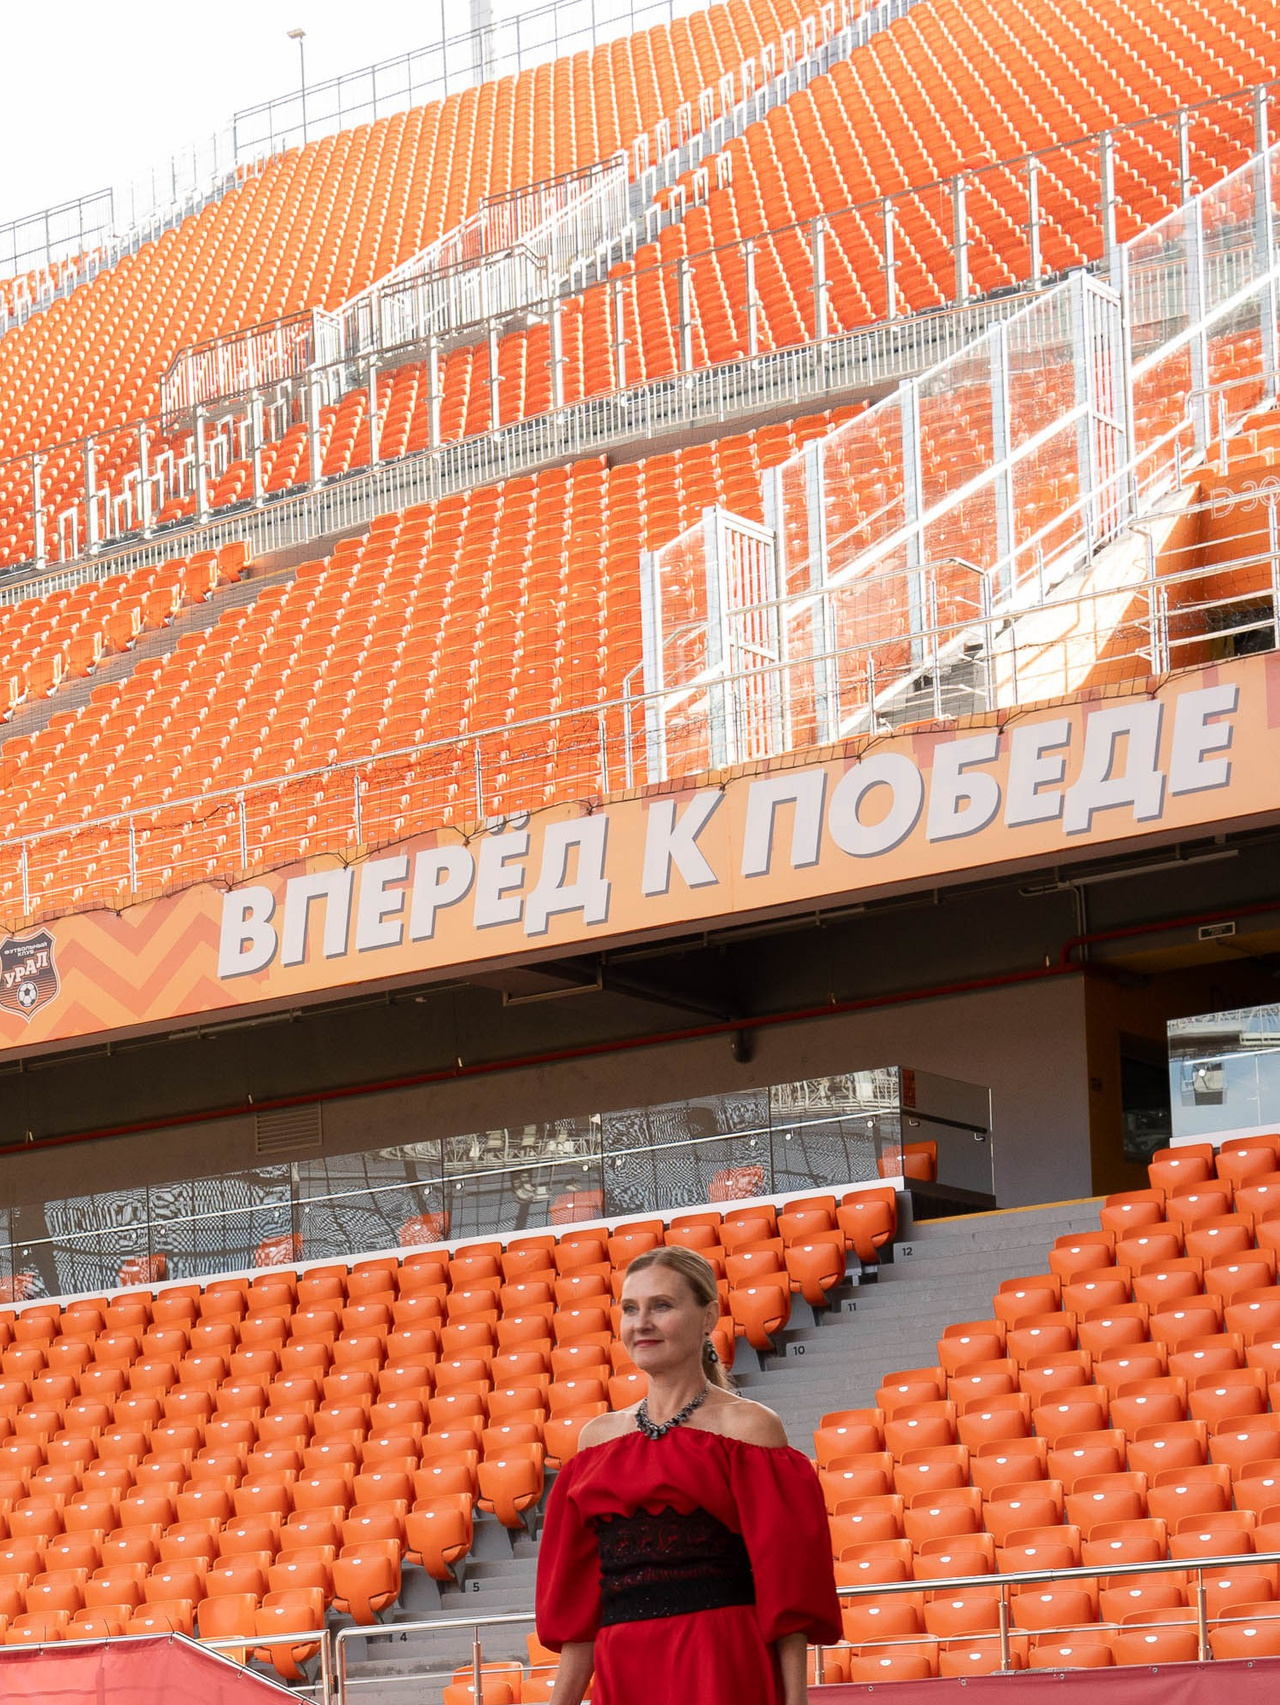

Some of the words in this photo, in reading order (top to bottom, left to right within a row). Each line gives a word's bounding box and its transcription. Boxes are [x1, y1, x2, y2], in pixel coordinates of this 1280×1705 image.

[218, 811, 612, 980] ВПЕРЁД
[641, 788, 725, 896] К
[741, 682, 1239, 880] ПОБЕДЕ
[4, 942, 47, 955] ФУТБОЛЬНЫЙ
[17, 949, 35, 957] КЛУБ
[4, 951, 48, 988] УРАЛ
[902, 1247, 913, 1256] 12
[848, 1303, 857, 1311] 11
[793, 1346, 805, 1355] 10
[472, 1582, 480, 1592] 5
[399, 1632, 407, 1642] 4
